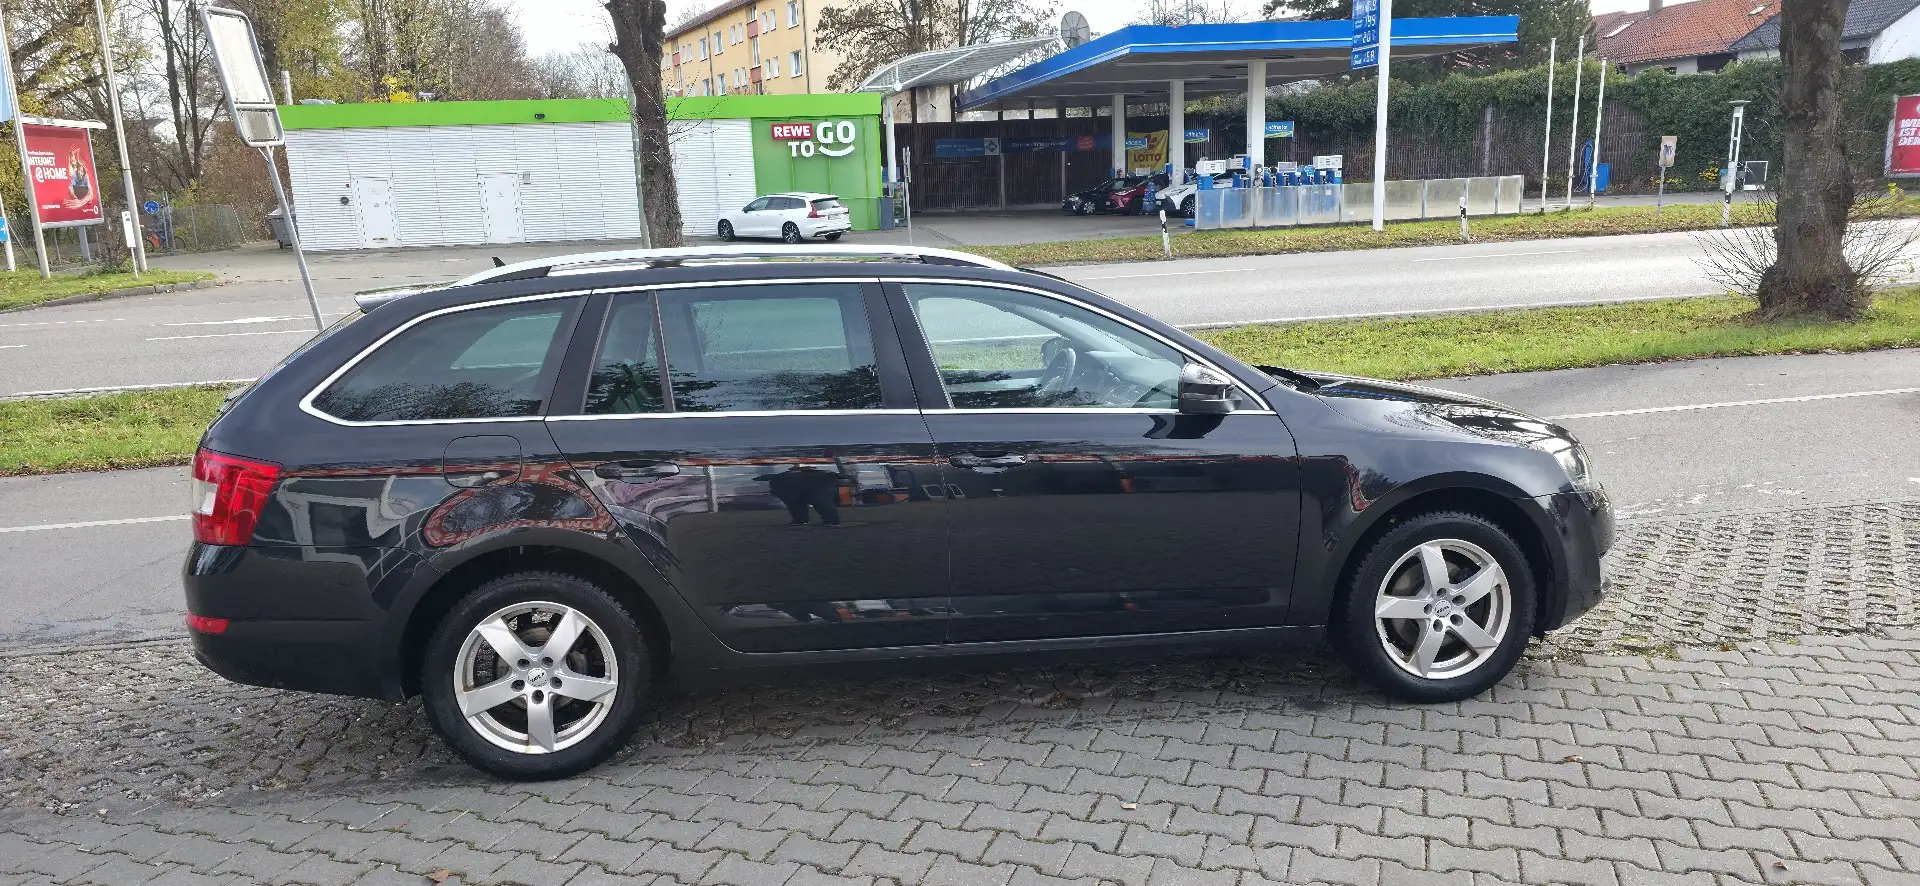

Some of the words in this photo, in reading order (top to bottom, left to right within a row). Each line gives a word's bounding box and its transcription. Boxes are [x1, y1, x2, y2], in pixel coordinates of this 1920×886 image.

[773, 125, 811, 138] REWE
[816, 121, 856, 144] GO
[787, 141, 815, 157] TO
[1133, 152, 1162, 163] LOTTO
[35, 166, 68, 183] @HOME
